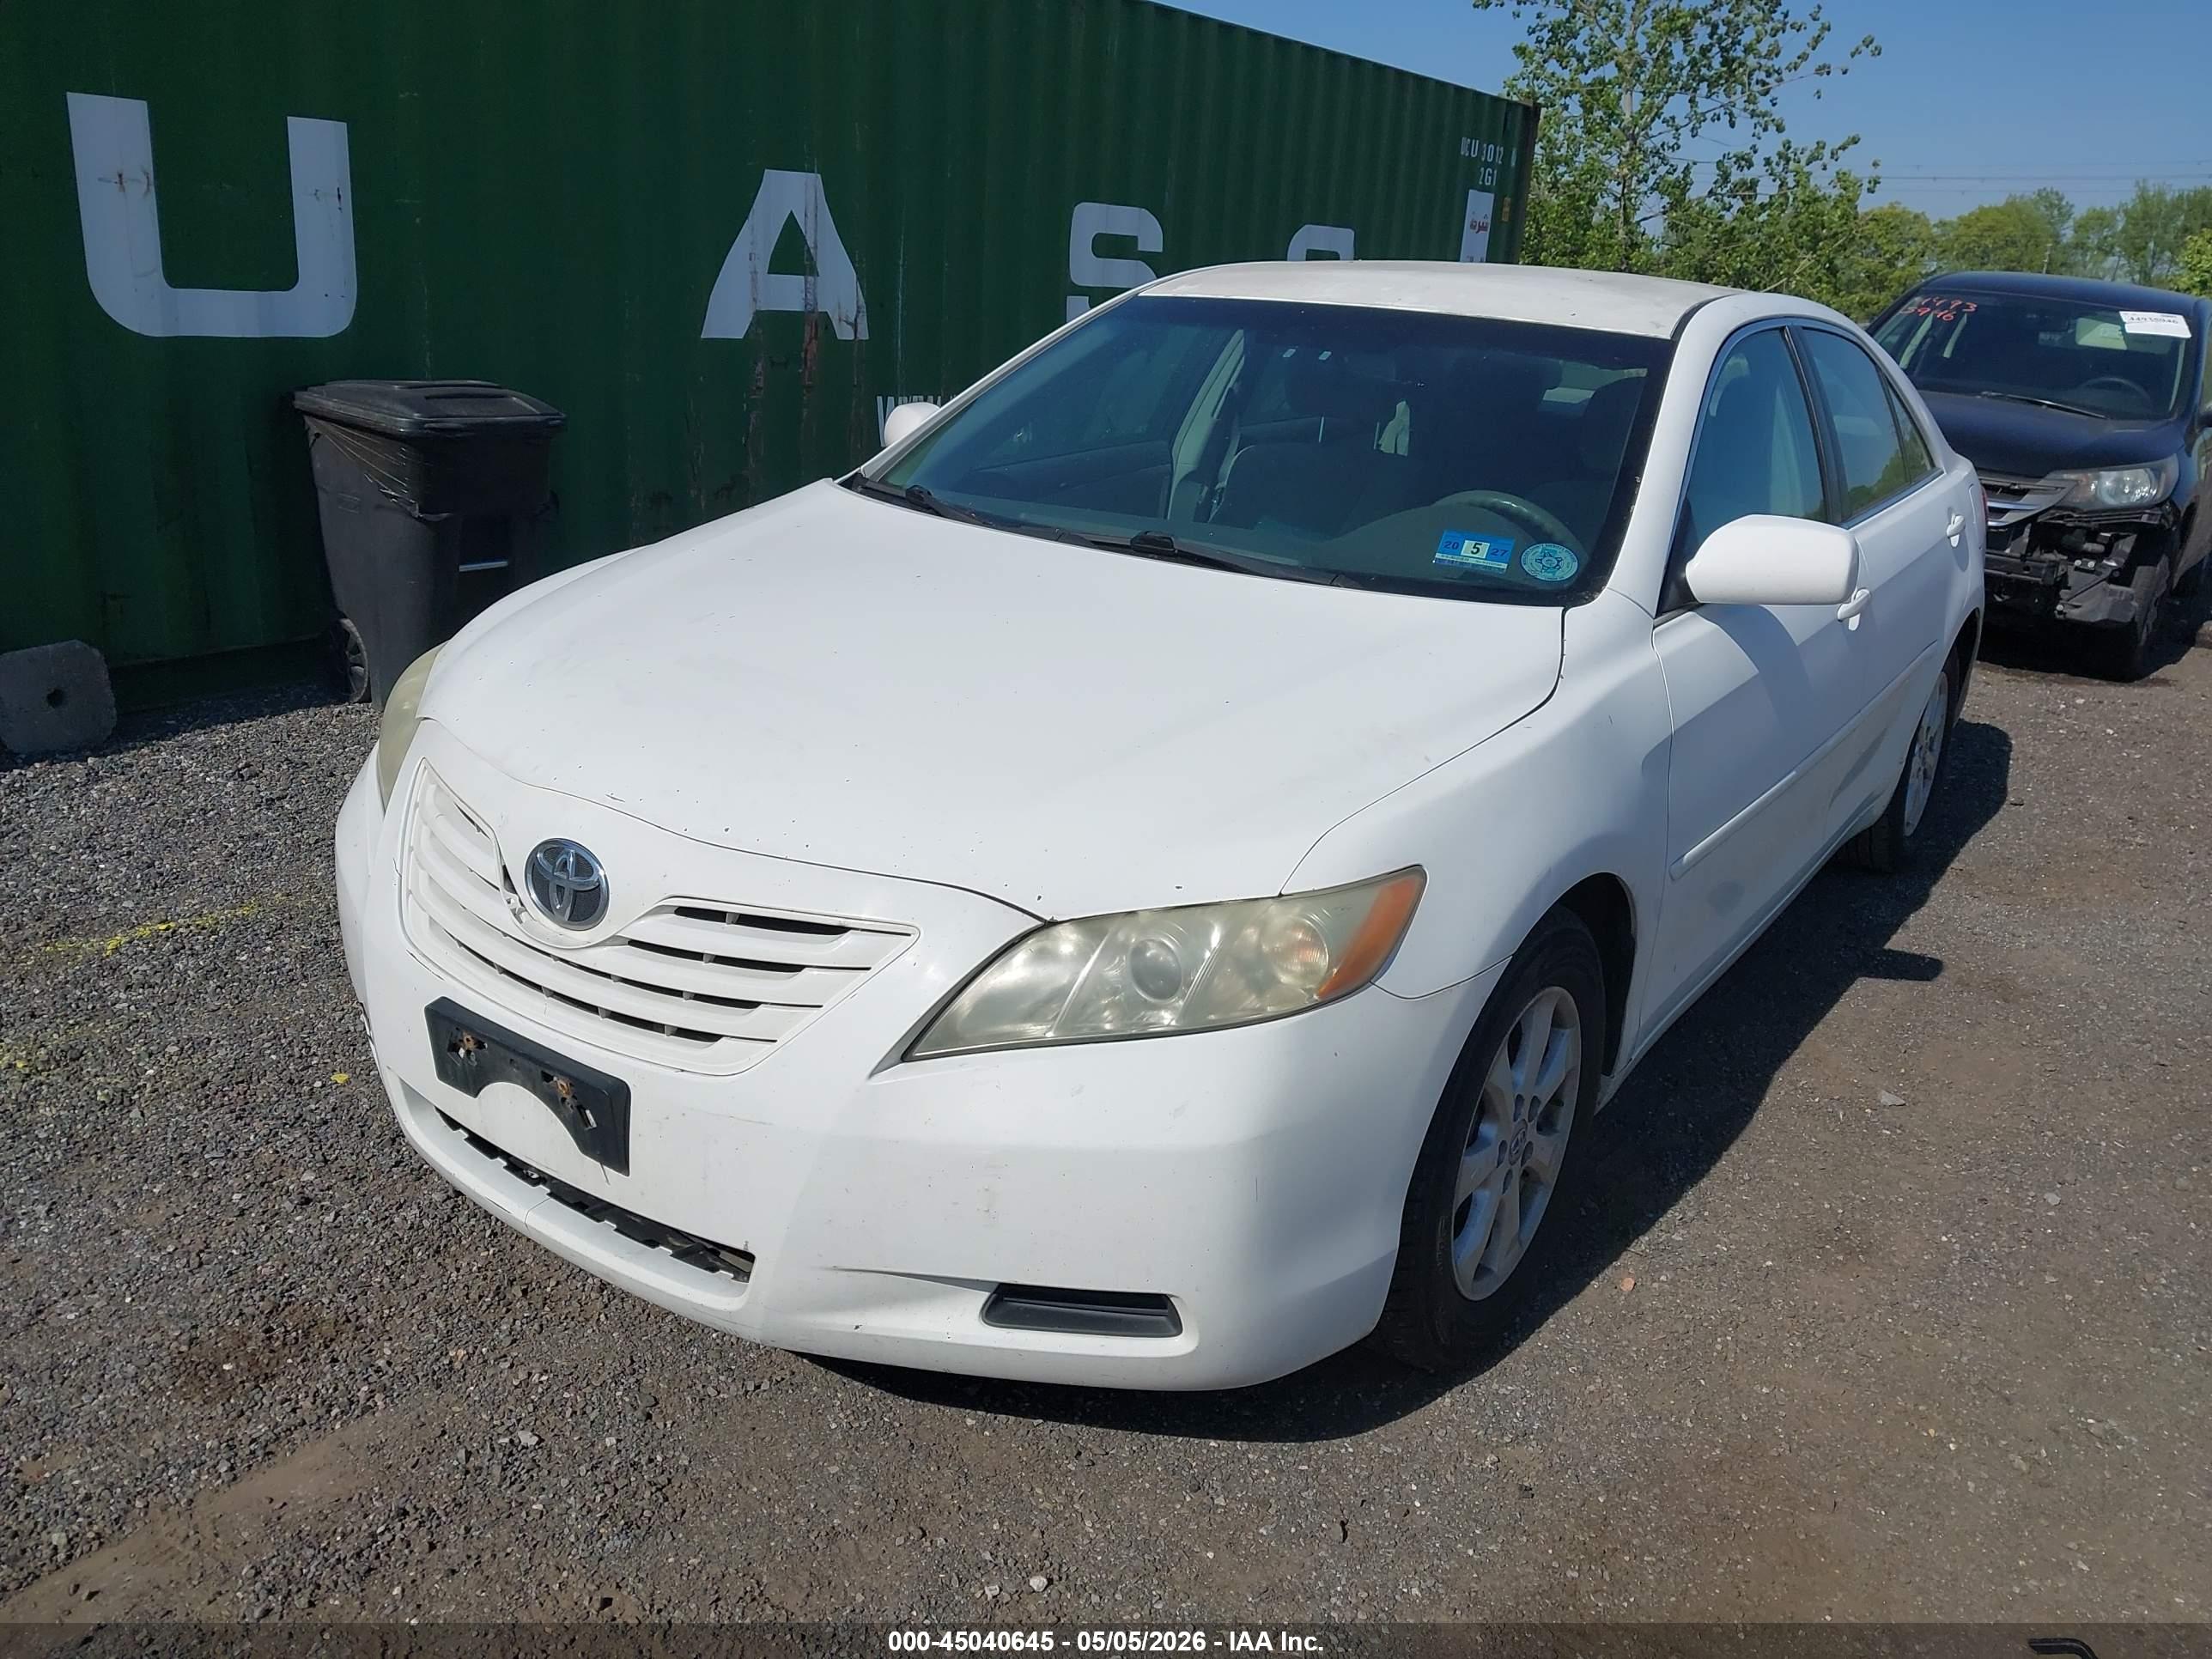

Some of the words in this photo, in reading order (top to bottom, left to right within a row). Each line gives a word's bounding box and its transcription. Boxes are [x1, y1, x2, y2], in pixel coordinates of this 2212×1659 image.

[1443, 540, 1460, 550] 20
[1470, 542, 1483, 555] 5
[1491, 548, 1509, 557] 27
